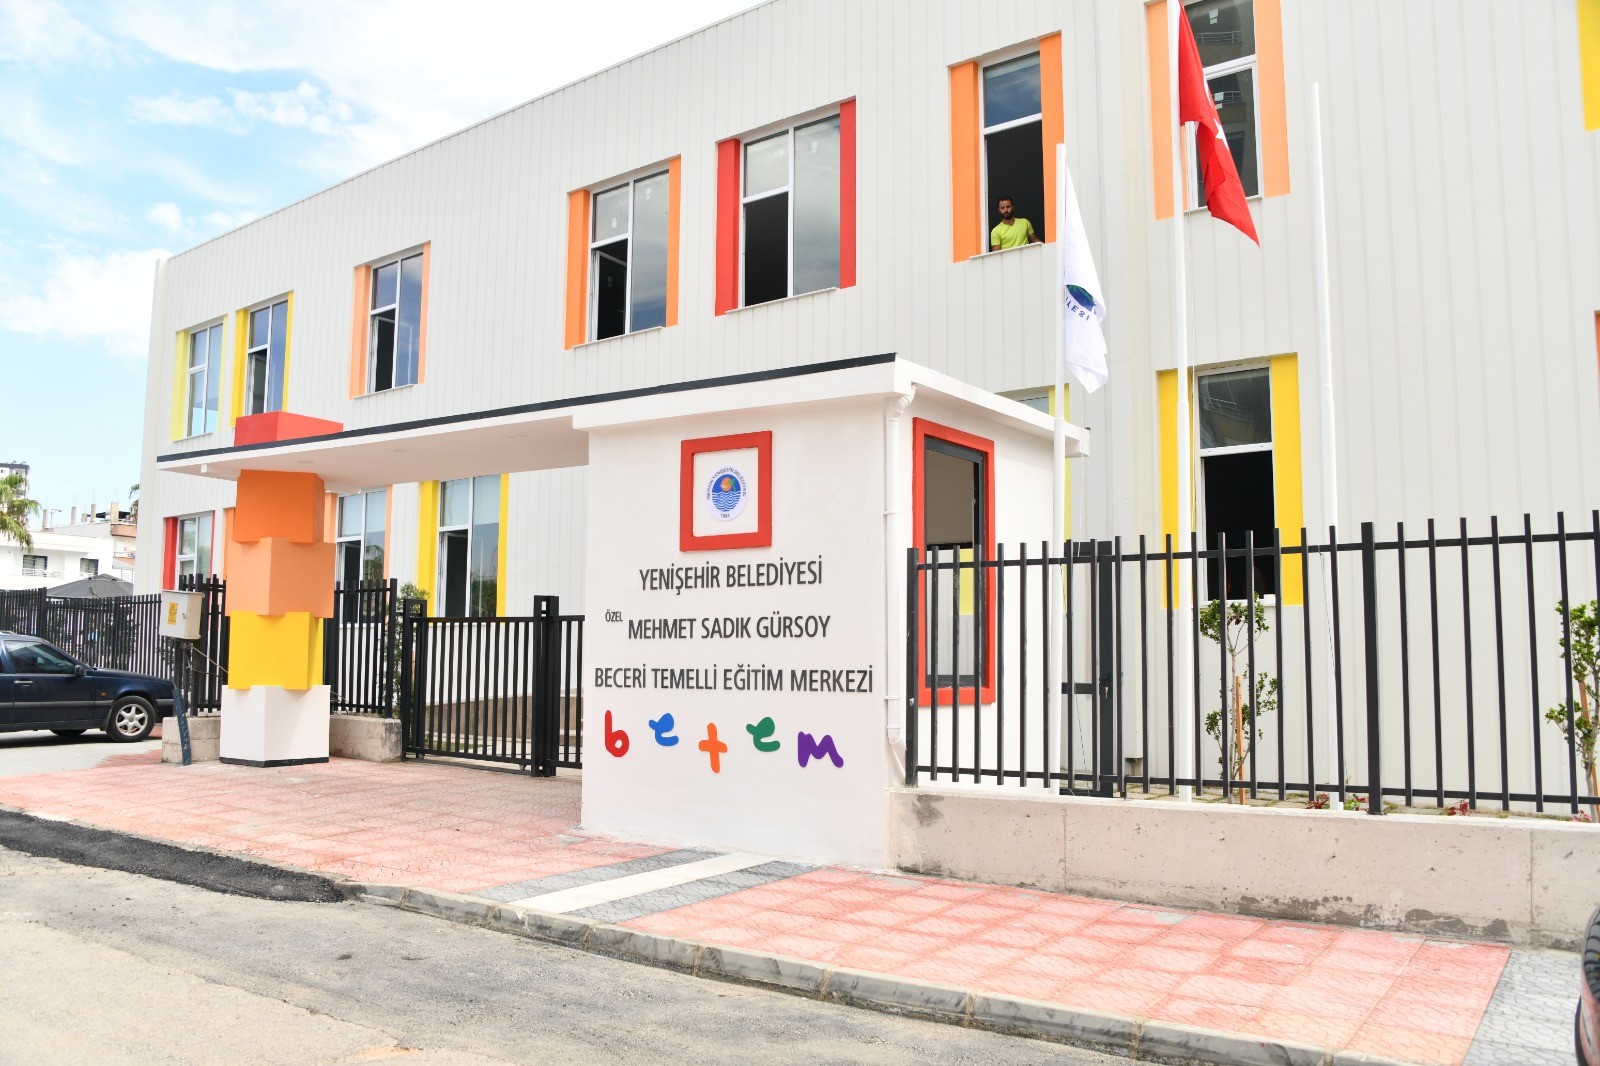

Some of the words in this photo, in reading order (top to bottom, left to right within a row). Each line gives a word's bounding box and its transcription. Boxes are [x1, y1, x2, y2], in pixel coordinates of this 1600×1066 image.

[639, 560, 721, 596] YENİŞEHİR
[726, 554, 823, 588] BELEDİYESİ
[605, 608, 624, 623] ÖZEL
[628, 618, 697, 640] MEHMET
[701, 616, 752, 639] SADIK
[756, 610, 831, 639] GÜRSOY
[594, 663, 647, 689] BECERİ
[651, 663, 717, 690] TEMELLİ
[723, 663, 783, 692] EĞİTİM
[790, 664, 873, 693] MERKEZİ
[605, 710, 843, 773] betem
